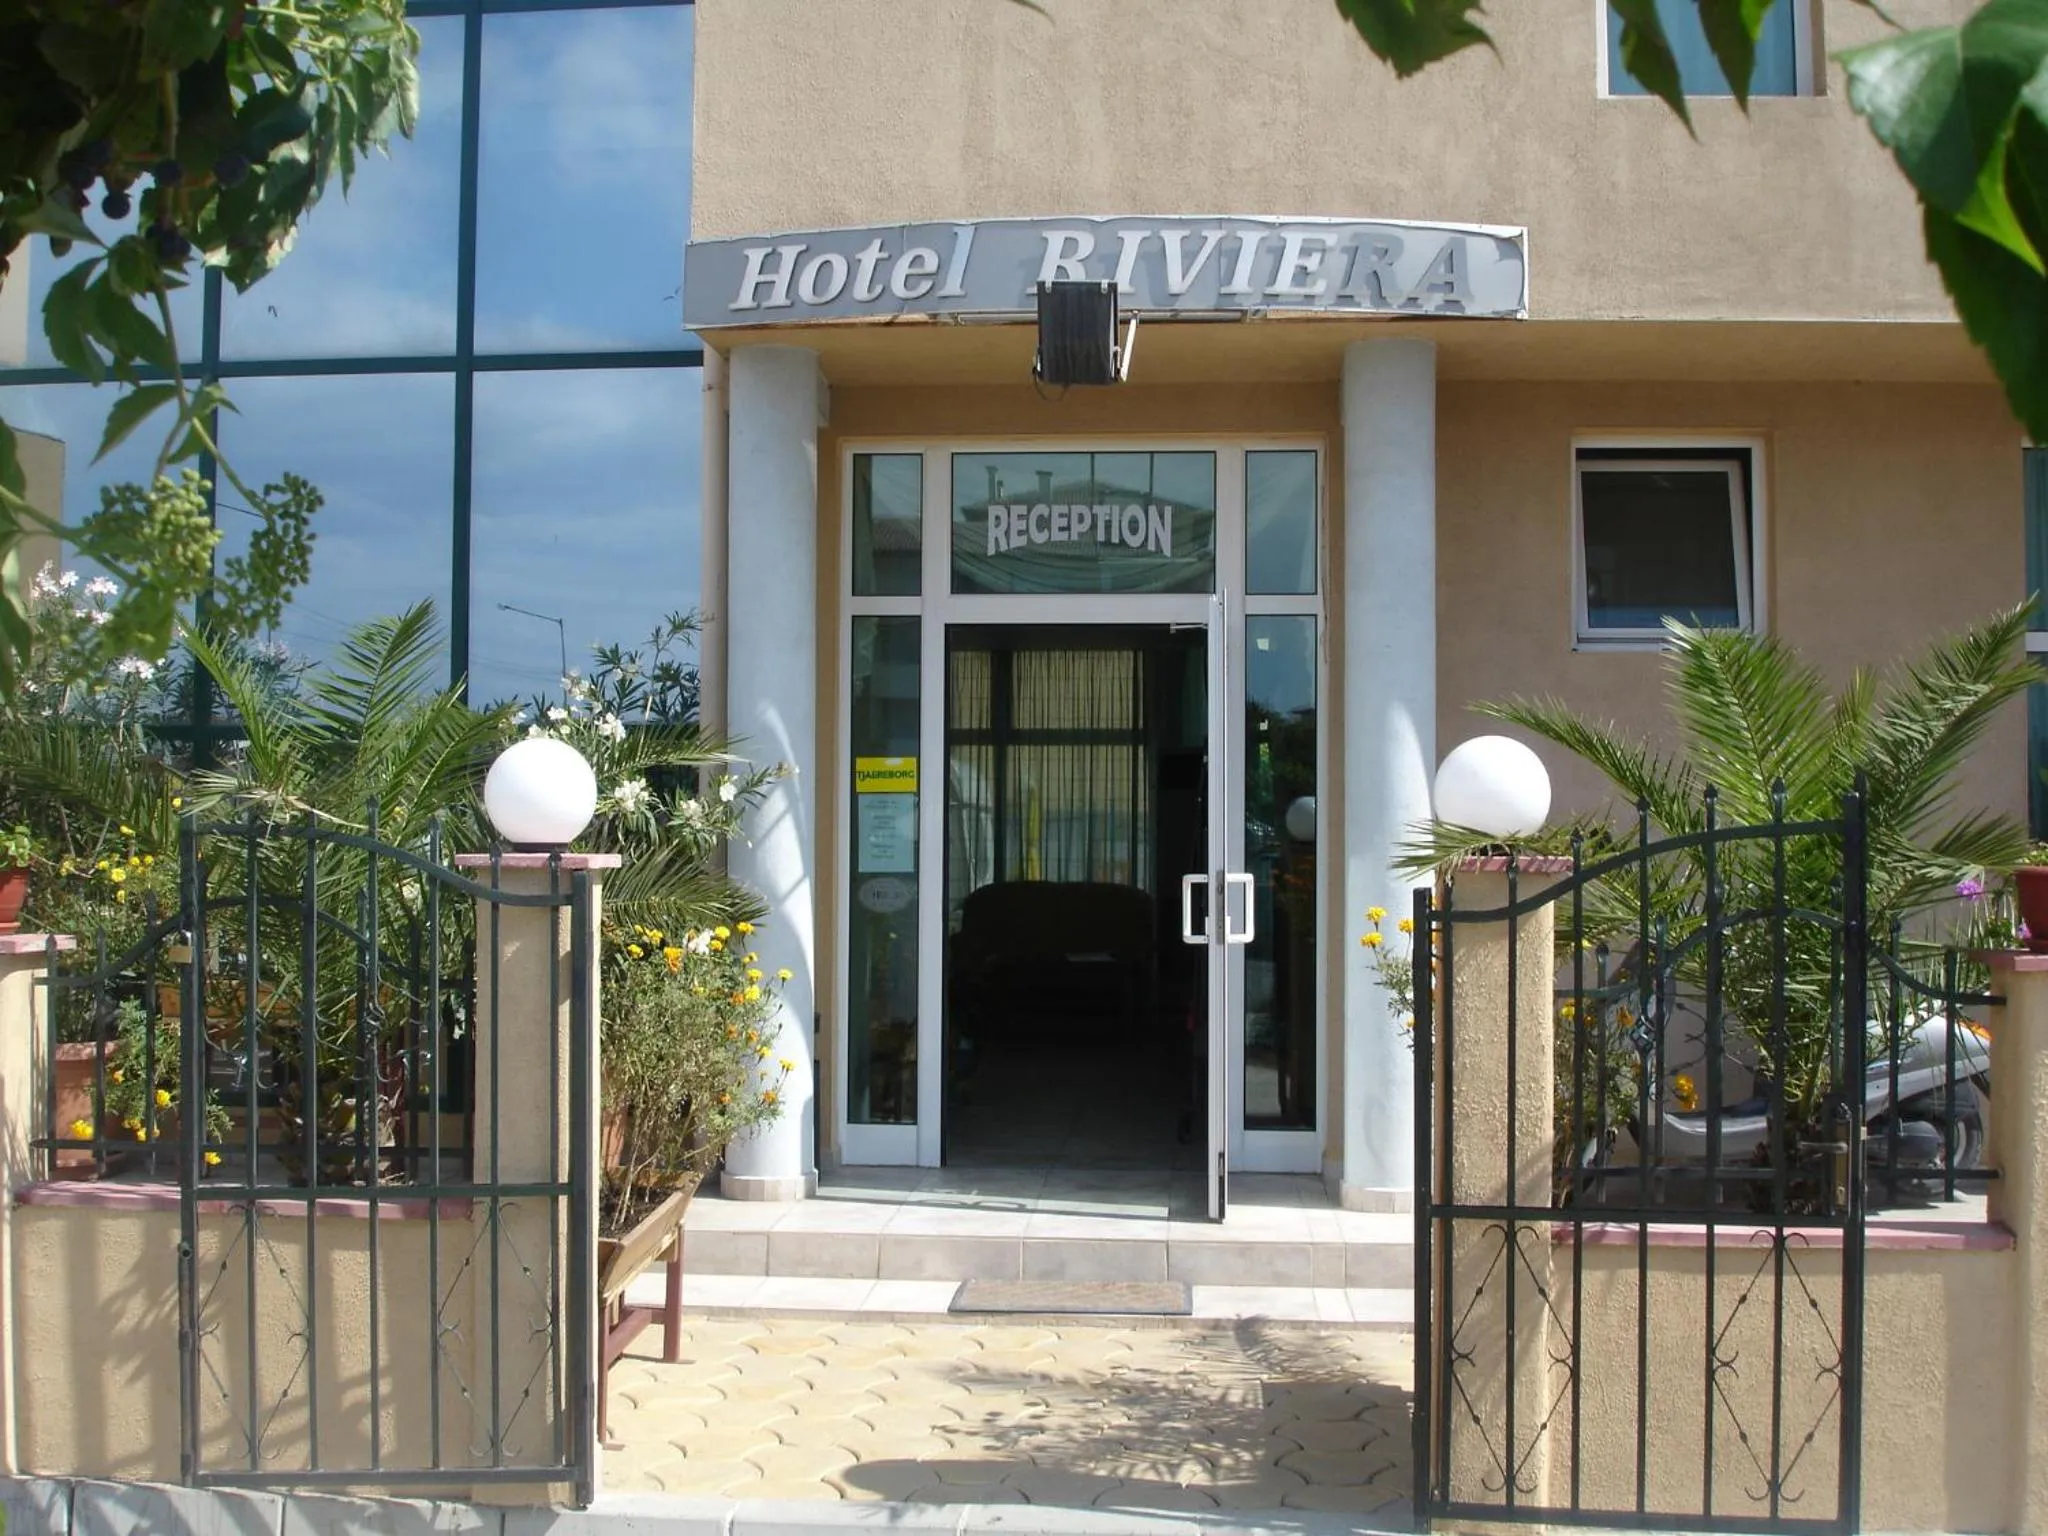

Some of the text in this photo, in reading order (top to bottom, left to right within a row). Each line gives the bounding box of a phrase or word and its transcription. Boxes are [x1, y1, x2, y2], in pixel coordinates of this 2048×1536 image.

[729, 226, 1475, 311] Hotel RIVIERA
[987, 504, 1172, 558] RECEPTION
